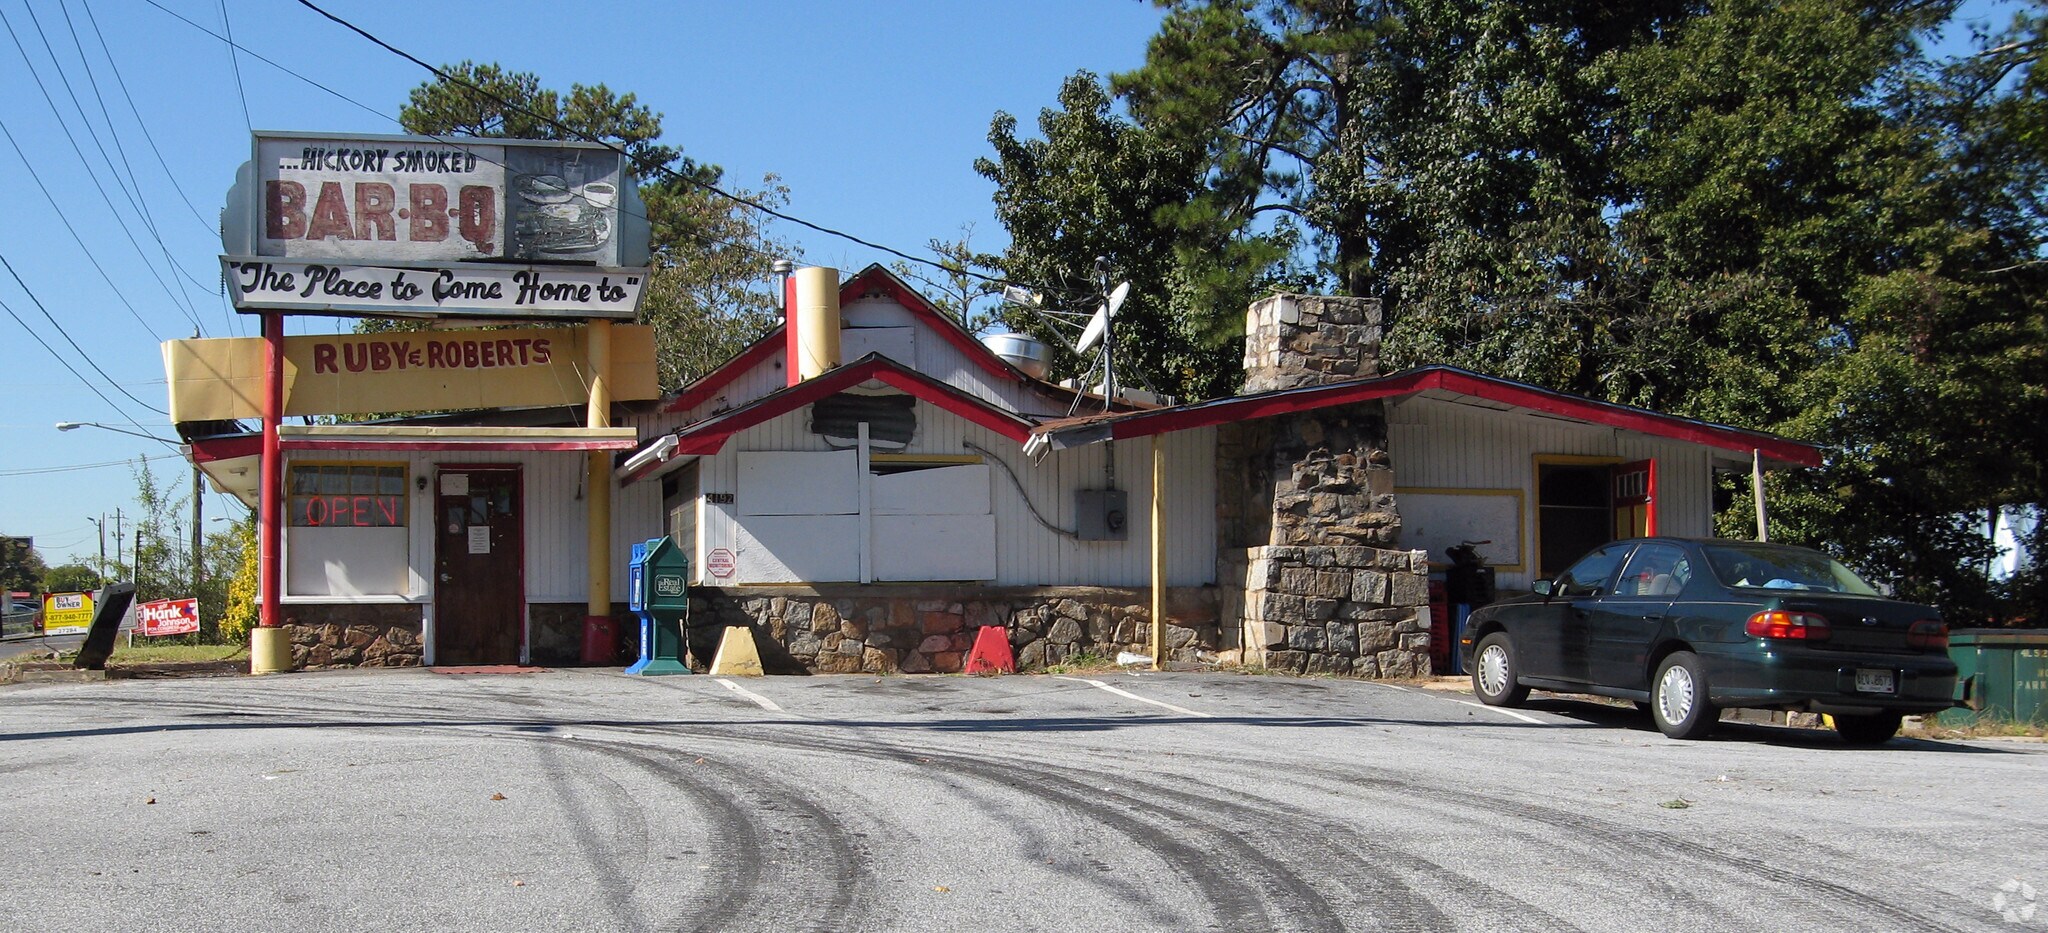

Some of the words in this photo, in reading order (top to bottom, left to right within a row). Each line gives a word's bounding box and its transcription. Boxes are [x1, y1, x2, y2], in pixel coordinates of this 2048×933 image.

[392, 149, 477, 173] SMOKED
[300, 264, 383, 300] Place
[391, 272, 423, 301] to
[432, 270, 503, 303] Come
[513, 270, 592, 305] Home
[314, 341, 410, 374] RUBY
[427, 338, 551, 369] ROBERTS
[306, 495, 397, 526] OPEN
[145, 604, 183, 620] Hank
[158, 617, 191, 627] Johnson
